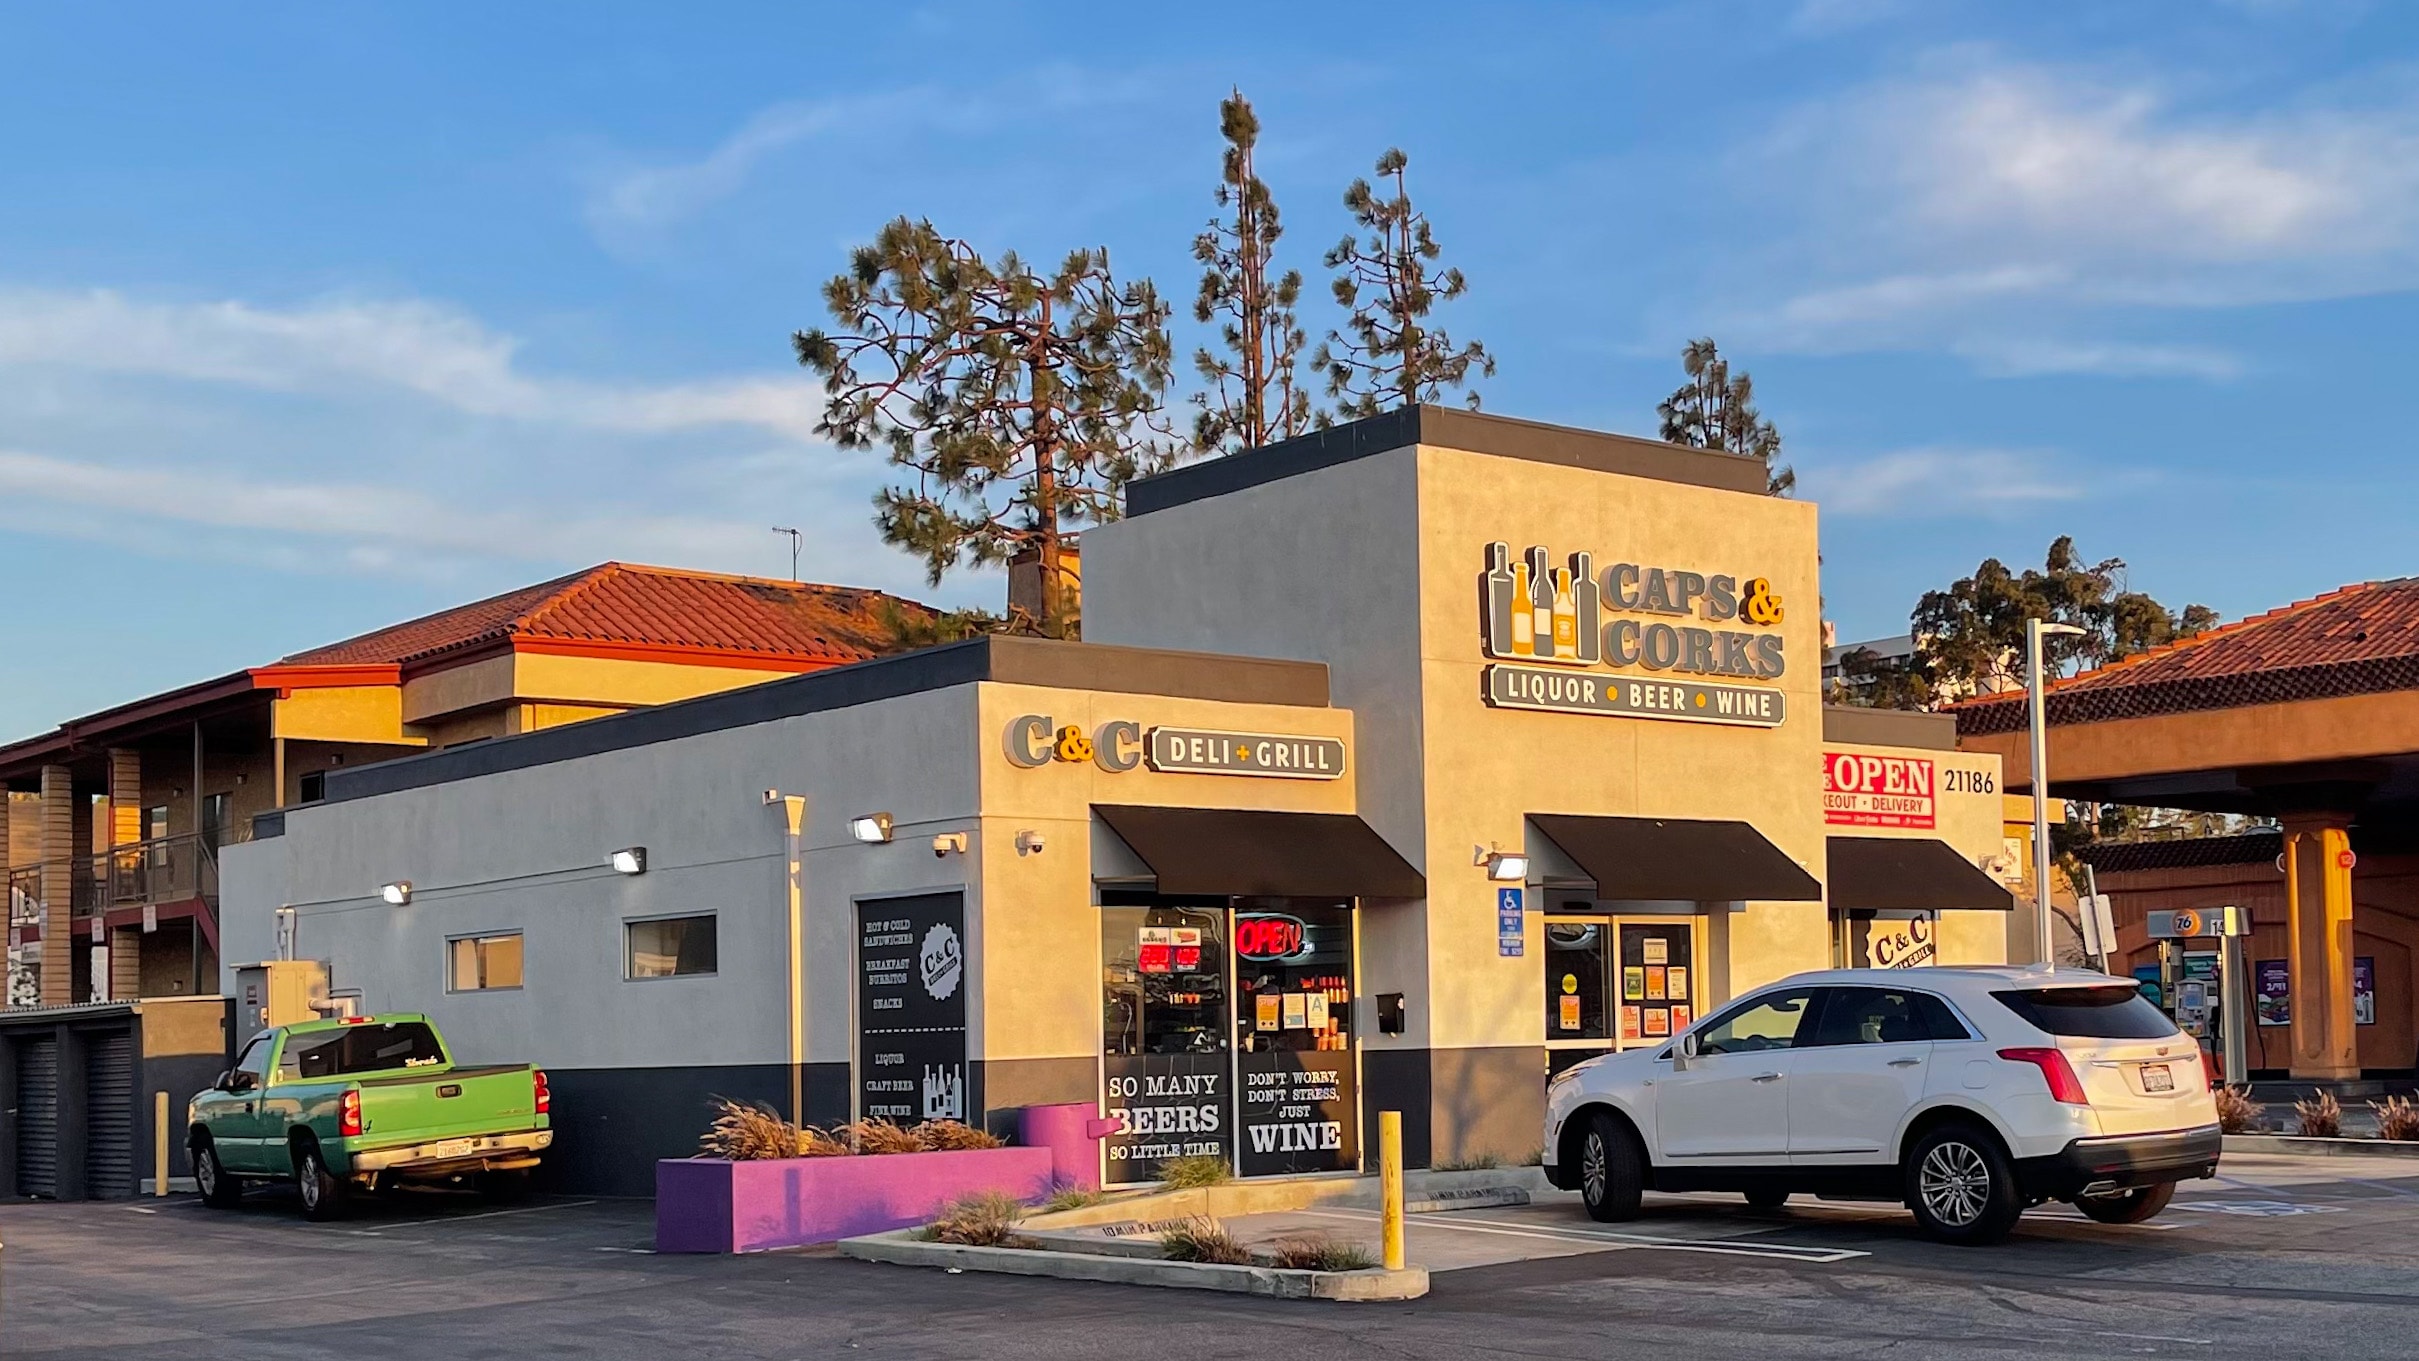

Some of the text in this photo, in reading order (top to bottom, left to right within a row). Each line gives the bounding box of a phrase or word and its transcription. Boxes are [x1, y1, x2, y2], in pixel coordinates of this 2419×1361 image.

[1600, 563, 1737, 621] CAPS
[1602, 620, 1786, 678] CORKS
[1507, 673, 1771, 718] LIQUOR BEER WINE
[1170, 736, 1330, 770] DELI GRILL
[1834, 755, 1931, 795] OPEN
[1944, 769, 1994, 794] 21186
[1872, 797, 1923, 813] DELIVERY
[866, 921, 881, 933] HOT
[890, 919, 911, 932] COLD
[2175, 915, 2192, 931] 76
[864, 933, 913, 947] SANDWICHES
[1238, 920, 1302, 954] OPEN
[866, 959, 910, 971] BREAKFAST
[869, 973, 907, 985] BURRITOS
[873, 998, 903, 1009] SNACKS
[1312, 996, 1323, 1012] A
[875, 1053, 904, 1066] LIQUOR
[866, 1080, 914, 1092] CRAFT BEER
[1109, 1074, 1218, 1098] SO MANY
[1248, 1070, 1340, 1086] DON'T WORRY,
[1248, 1087, 1341, 1103] DON'T STRESS,
[890, 1105, 912, 1116] WINE
[1279, 1105, 1311, 1118] JUST
[1110, 1104, 1220, 1135] BEERS
[1248, 1121, 1341, 1153] WINE
[1110, 1142, 1220, 1160] SO LITTLE TIME
